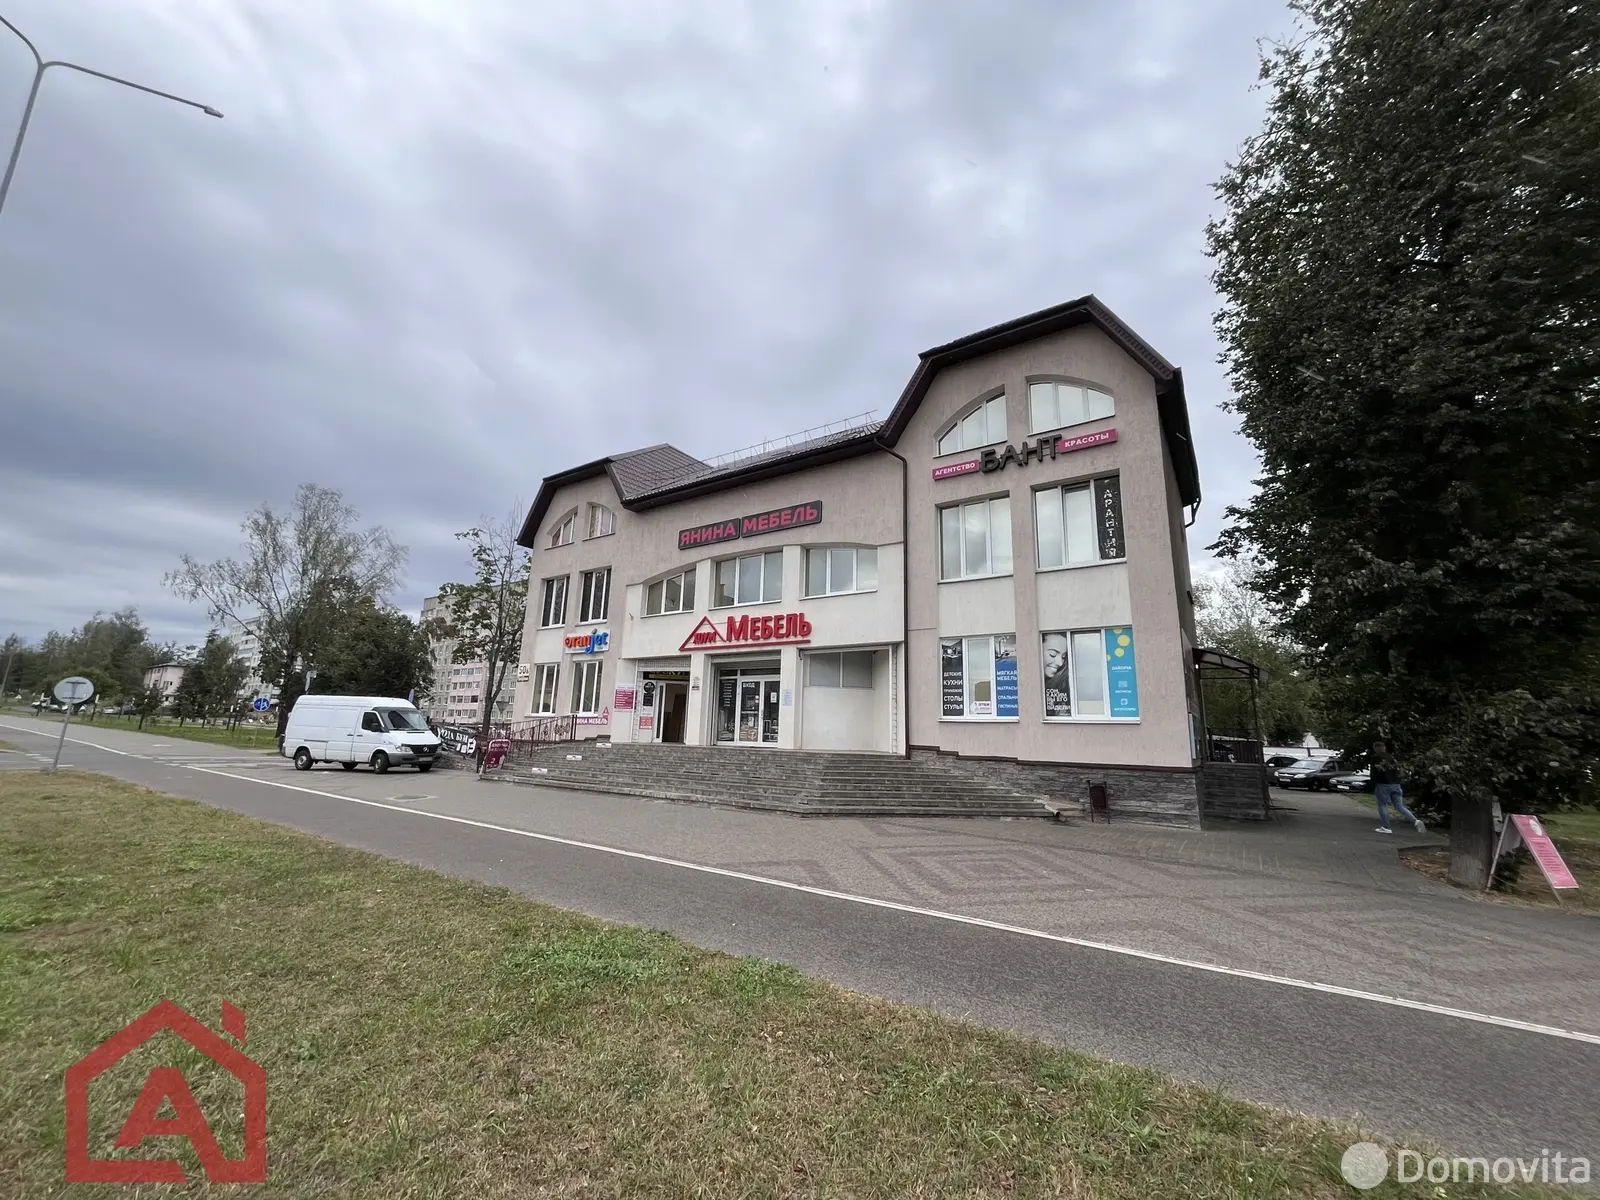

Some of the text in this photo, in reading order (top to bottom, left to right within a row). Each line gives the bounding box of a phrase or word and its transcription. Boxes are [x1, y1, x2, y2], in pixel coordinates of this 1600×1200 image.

[935, 432, 1109, 477] АГЕНТСТВО БАНТ КРАСОТЫ
[680, 506, 818, 546] ЯНИНА МЕБЕЛЬ
